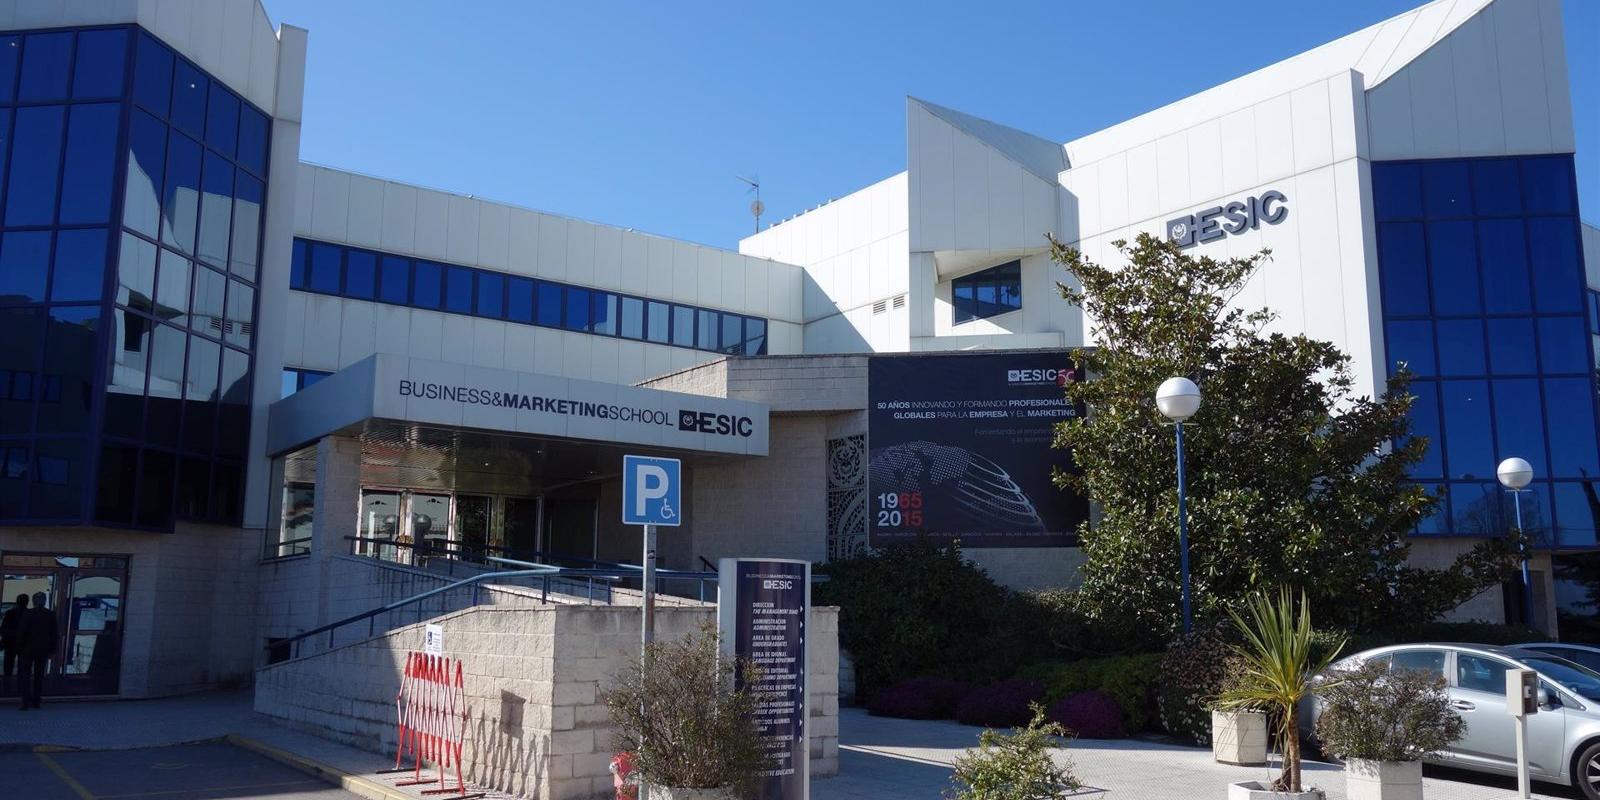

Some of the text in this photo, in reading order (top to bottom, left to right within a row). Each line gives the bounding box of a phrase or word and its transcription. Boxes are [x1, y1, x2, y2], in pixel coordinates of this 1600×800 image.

[1195, 189, 1289, 244] ESIC
[1021, 368, 1057, 382] ESIC
[887, 400, 911, 409] AÑOS
[911, 400, 956, 409] INNOVANDO
[957, 400, 963, 408] Y
[963, 400, 1008, 409] FORMANDO
[893, 411, 936, 419] GLOBALES
[937, 411, 957, 419] PARA
[969, 410, 1008, 418] EMPRESA
[1027, 409, 1076, 417] MARKETING
[699, 411, 753, 438] ESIC
[636, 464, 669, 516] P
[877, 492, 922, 509] 1965
[877, 510, 922, 527] 2015
[772, 580, 793, 590] ESIC
